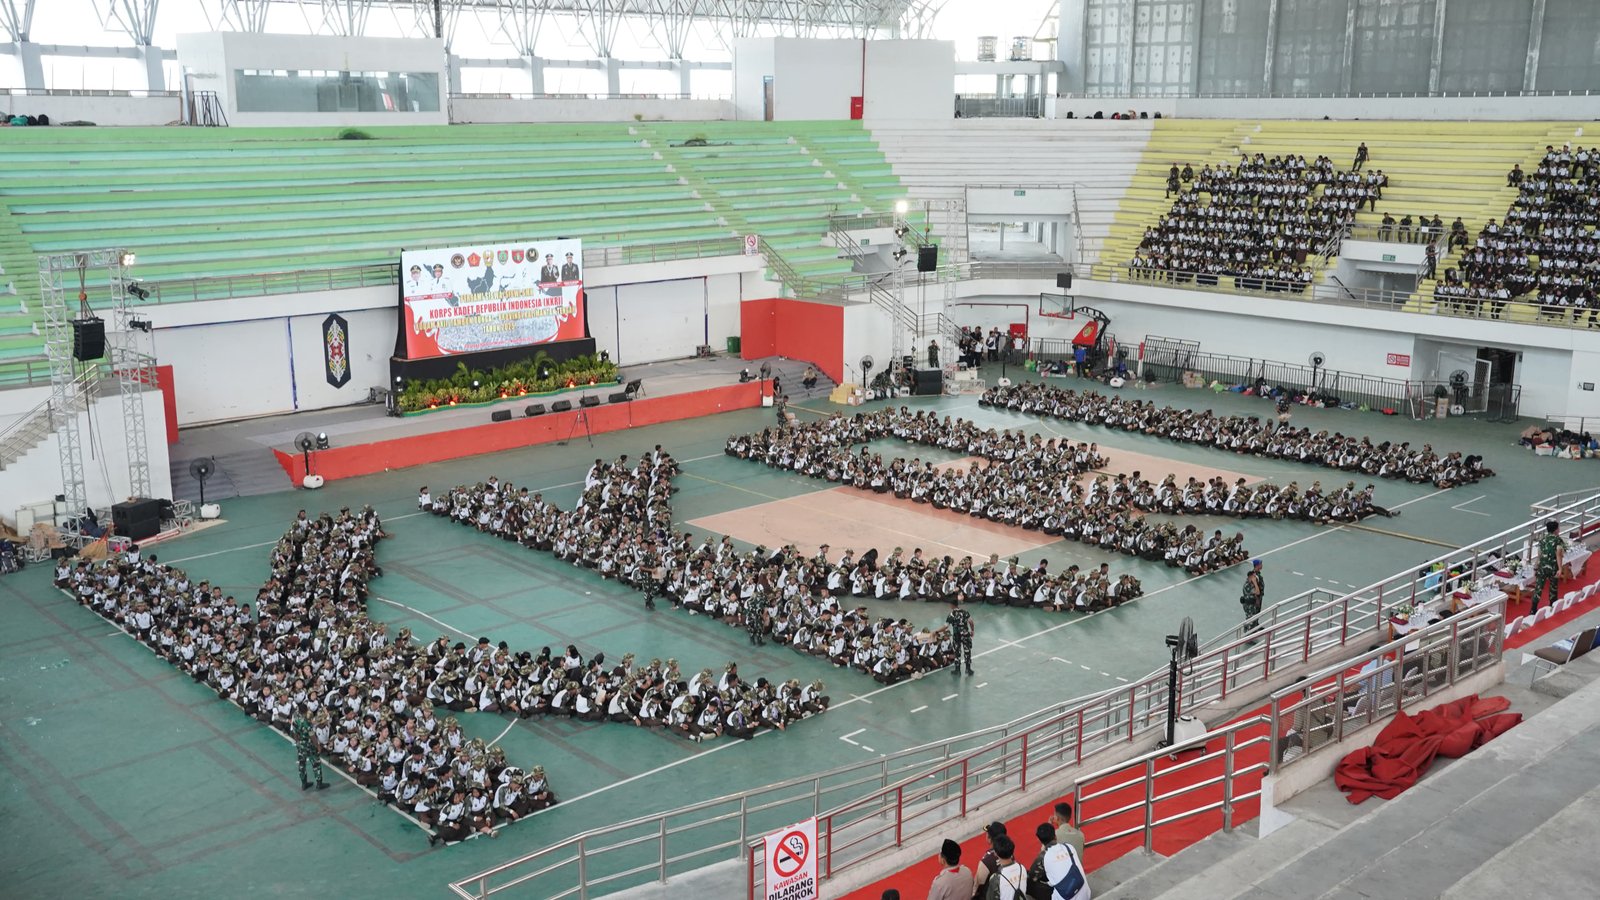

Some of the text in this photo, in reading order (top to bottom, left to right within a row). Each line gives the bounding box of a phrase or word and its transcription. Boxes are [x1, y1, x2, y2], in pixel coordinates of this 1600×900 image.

[429, 307, 452, 319] KORPS
[453, 305, 474, 317] KADET
[475, 301, 507, 315] REPUBLIK
[508, 298, 542, 311] INDONESIA
[769, 877, 813, 900] DILARANG
[773, 871, 808, 891] KAWASAN
